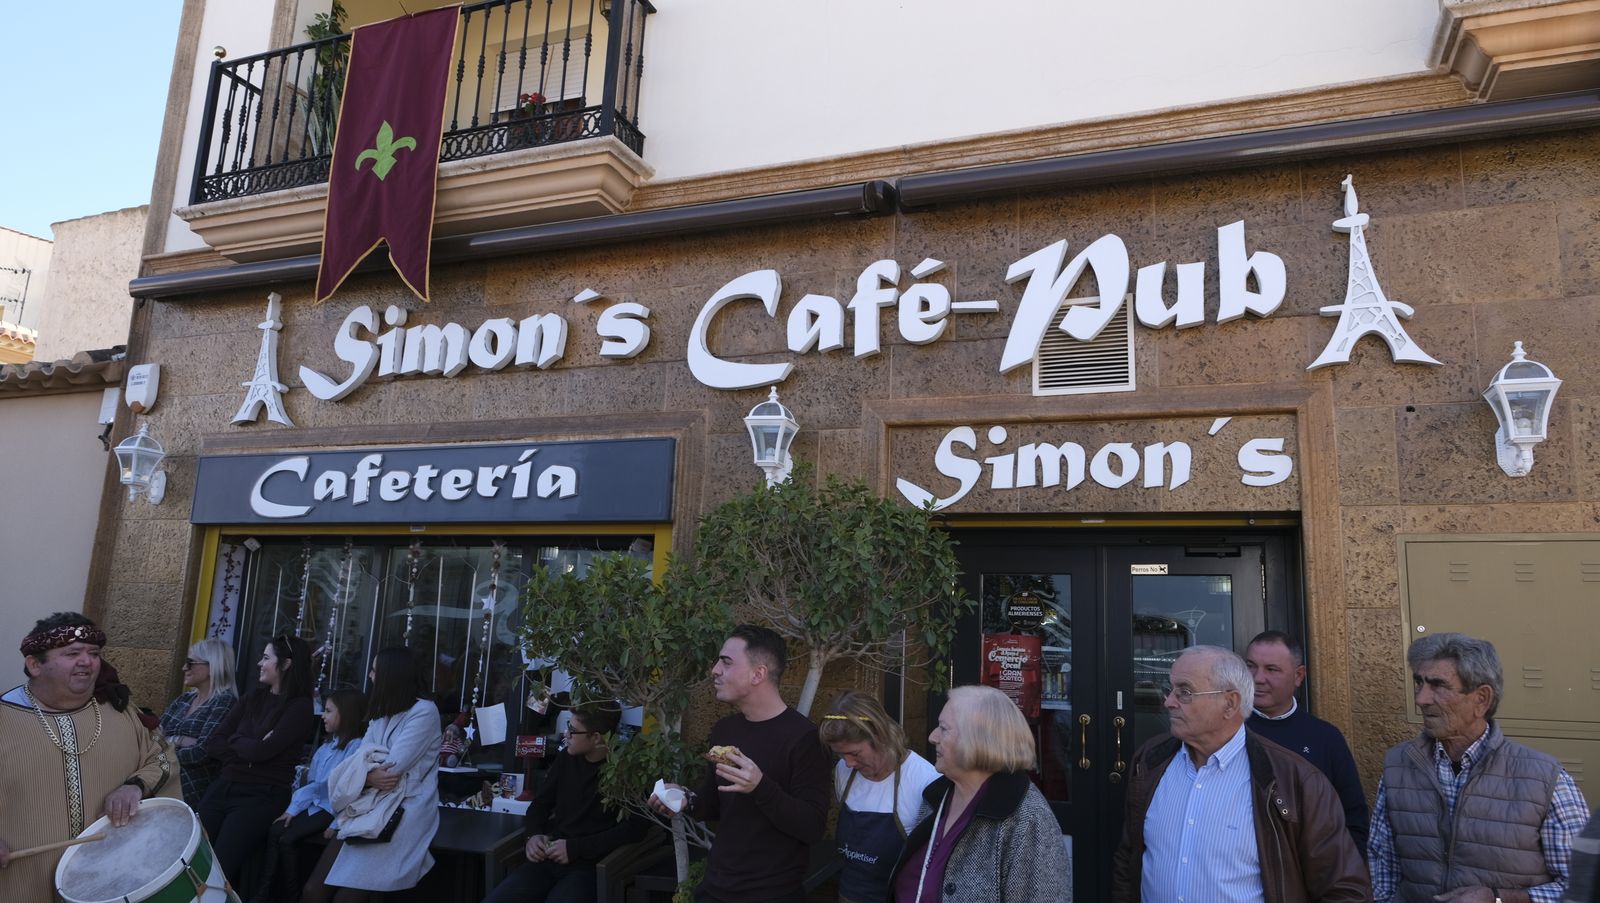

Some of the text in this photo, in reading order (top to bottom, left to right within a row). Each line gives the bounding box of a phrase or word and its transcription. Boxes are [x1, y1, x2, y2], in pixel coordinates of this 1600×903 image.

[687, 219, 1287, 390] Café-Pub
[250, 448, 578, 518] Cafetería
[988, 650, 1028, 663] Comercio
[1000, 661, 1021, 670] Local
[837, 843, 879, 865] Appletiser
